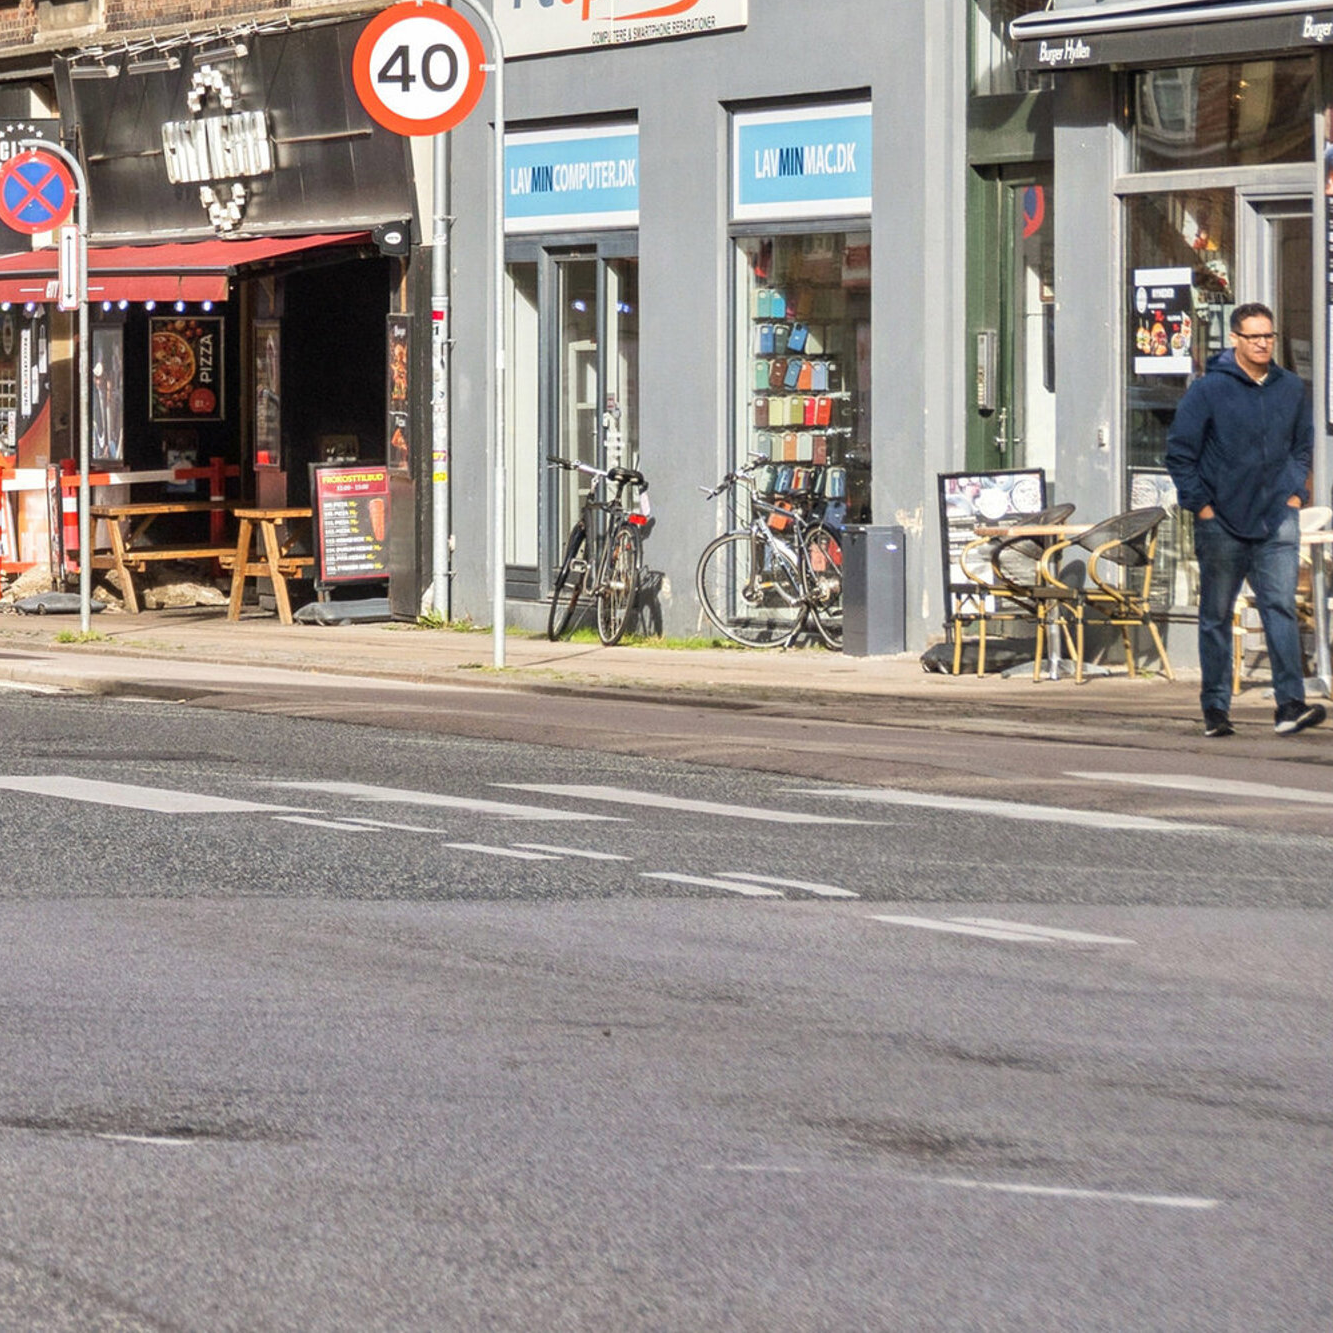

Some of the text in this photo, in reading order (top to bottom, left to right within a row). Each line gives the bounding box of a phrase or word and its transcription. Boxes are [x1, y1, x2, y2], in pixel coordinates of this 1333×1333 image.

[632, 23, 671, 40] SMARTPHONE
[672, 15, 716, 36] REPARATIONER
[377, 43, 459, 92] 40
[1039, 38, 1091, 65] Burger Hytten
[510, 159, 636, 195] LAVMINCOMPUTER.DK
[754, 142, 857, 179] LAVMINMAC.DK
[200, 333, 213, 383] PIZZA
